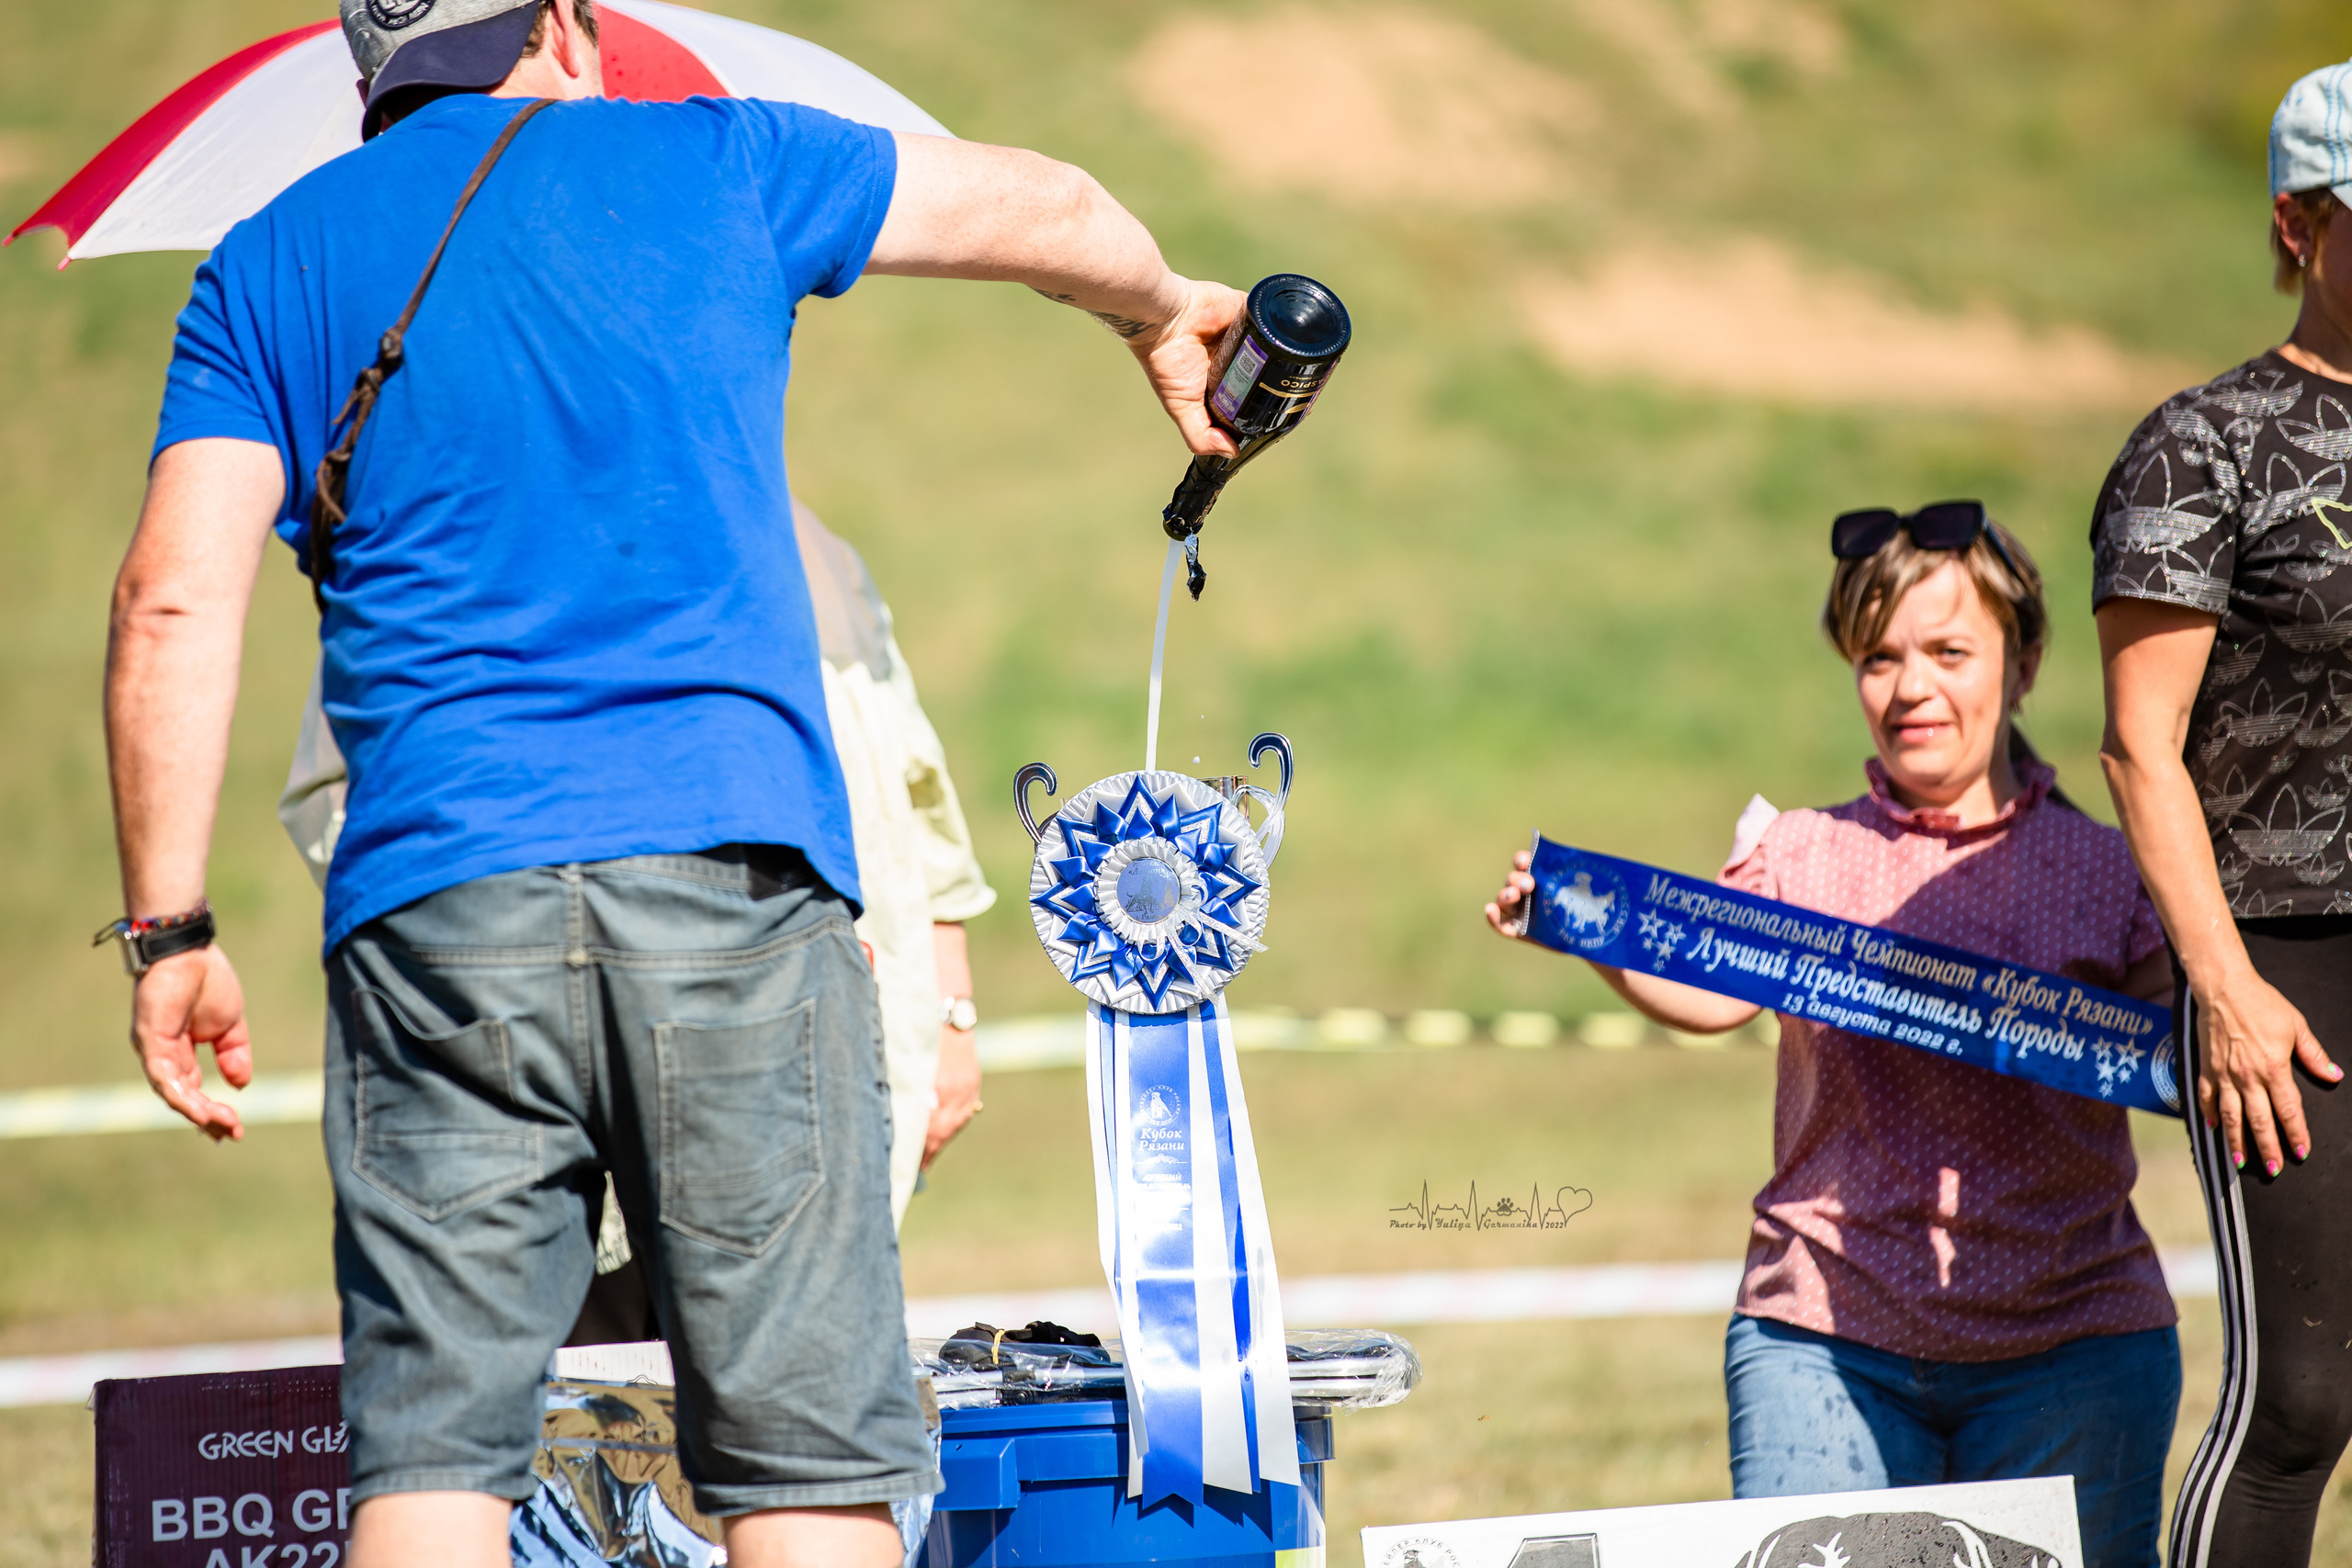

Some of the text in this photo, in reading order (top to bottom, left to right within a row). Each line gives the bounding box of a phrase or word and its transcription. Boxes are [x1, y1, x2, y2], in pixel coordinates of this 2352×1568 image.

[1644, 874, 1849, 955] Межрегиональный
[1850, 928, 1977, 991] Чемпионат
[1982, 967, 2062, 1013] «Кубок
[2064, 987, 2154, 1035] Рязани»
[1685, 927, 2086, 1061] Лучший Представитель Породы
[1781, 993, 1804, 1014] 13
[1806, 1000, 1893, 1035] августа
[1893, 1023, 1945, 1050] 2022
[1138, 1140, 1185, 1152] Рязани
[1140, 1128, 1182, 1142] Кубок
[198, 1429, 294, 1461] GREEN
[152, 1493, 276, 1542] BBQ
[205, 1540, 351, 1568] AK22
